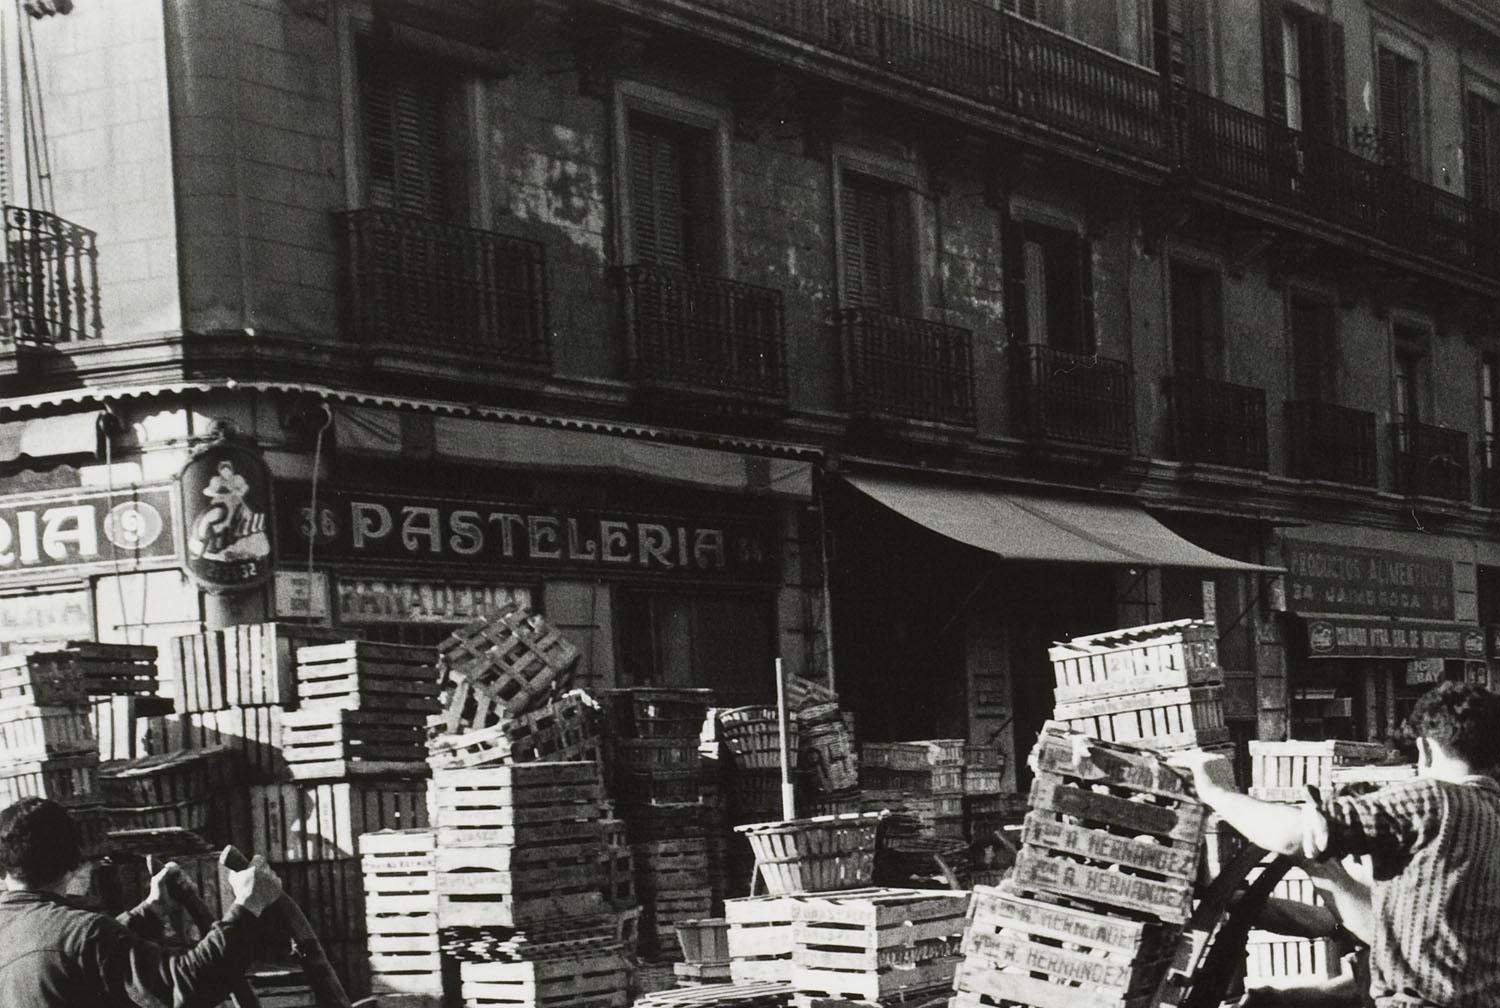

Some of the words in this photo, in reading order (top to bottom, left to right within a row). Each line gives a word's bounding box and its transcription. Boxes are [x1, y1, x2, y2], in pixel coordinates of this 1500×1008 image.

[122, 509, 145, 542] 9
[351, 502, 725, 568] PASTELERIA
[1027, 947, 1130, 988] HERNANDEZ
